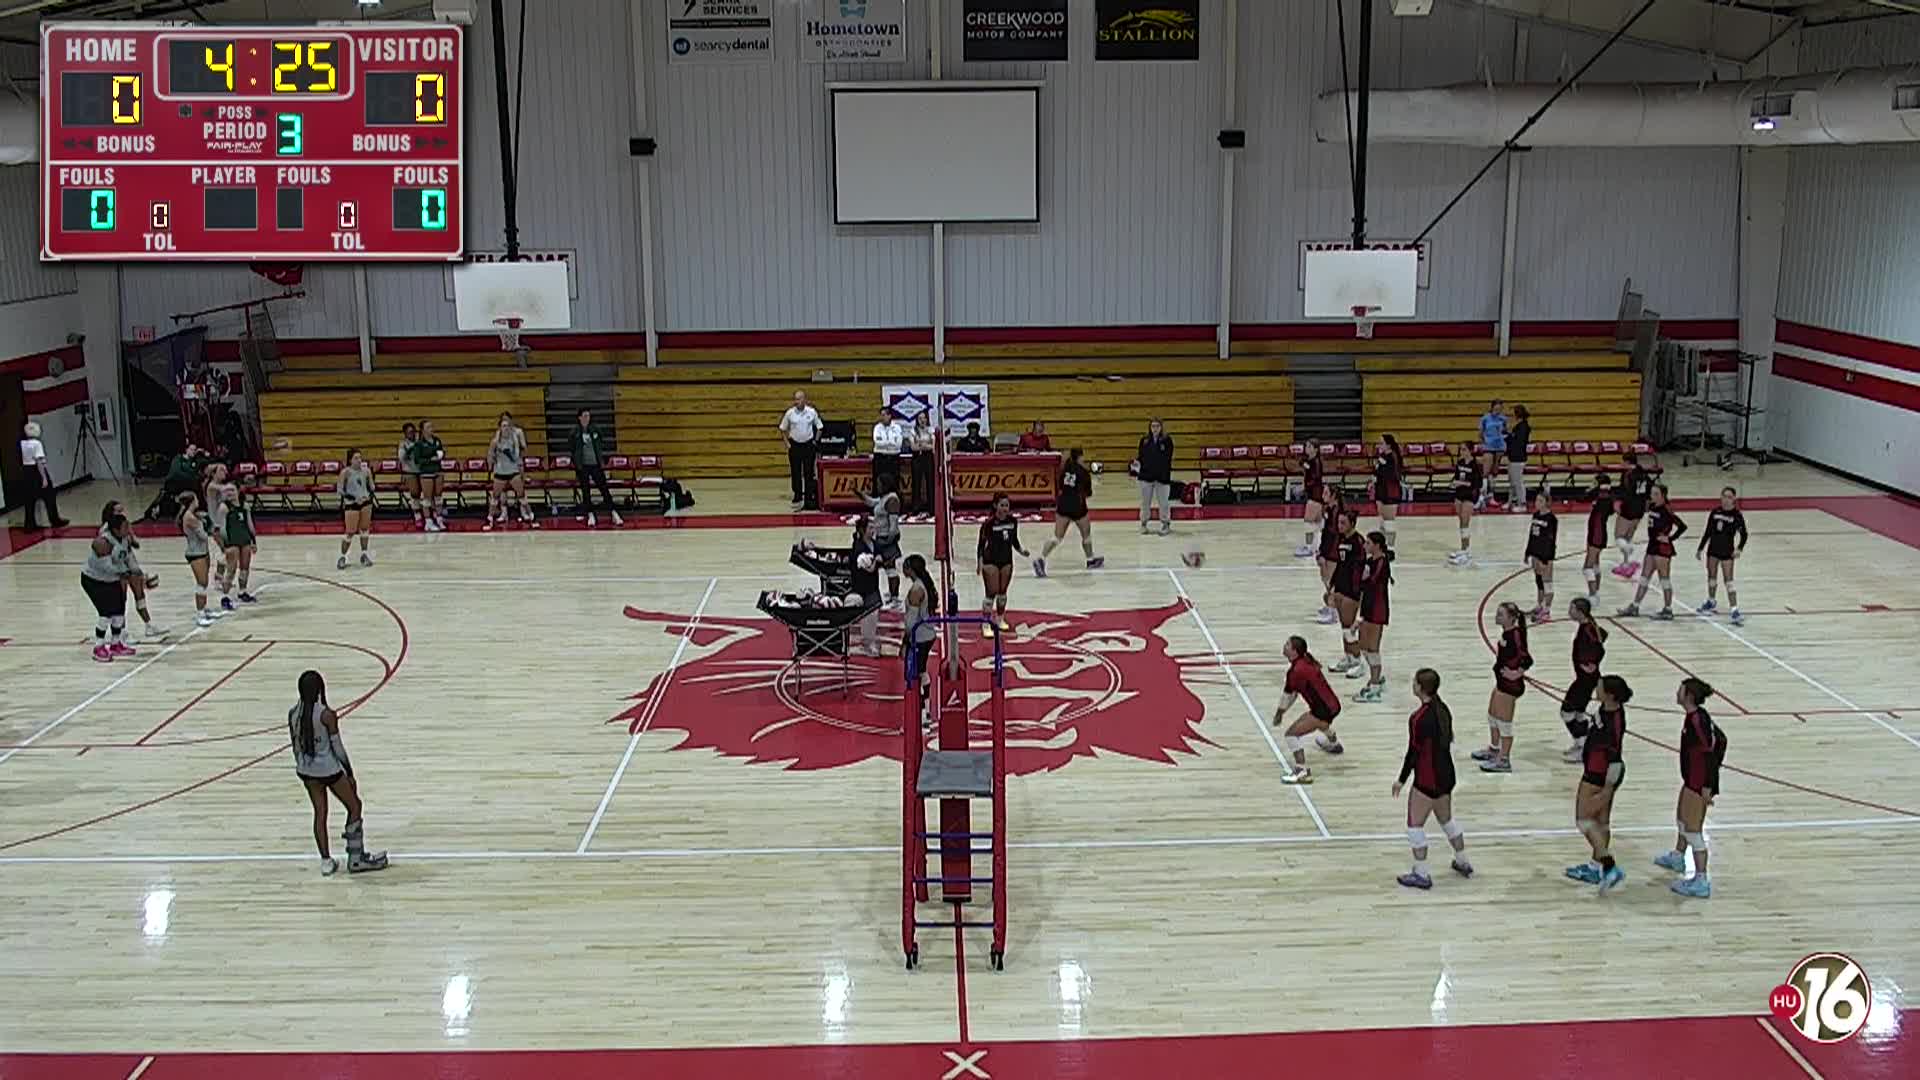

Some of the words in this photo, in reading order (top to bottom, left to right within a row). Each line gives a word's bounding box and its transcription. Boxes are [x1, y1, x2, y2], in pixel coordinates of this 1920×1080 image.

[703, 5, 758, 15] SERVICES
[966, 12, 1065, 29] CREEKWOOD
[806, 21, 900, 36] Hometown
[967, 31, 1005, 39] MOTOR
[1010, 31, 1064, 39] COMPANY
[1099, 29, 1195, 41] STALLION
[950, 473, 1051, 490] WILDCATS
